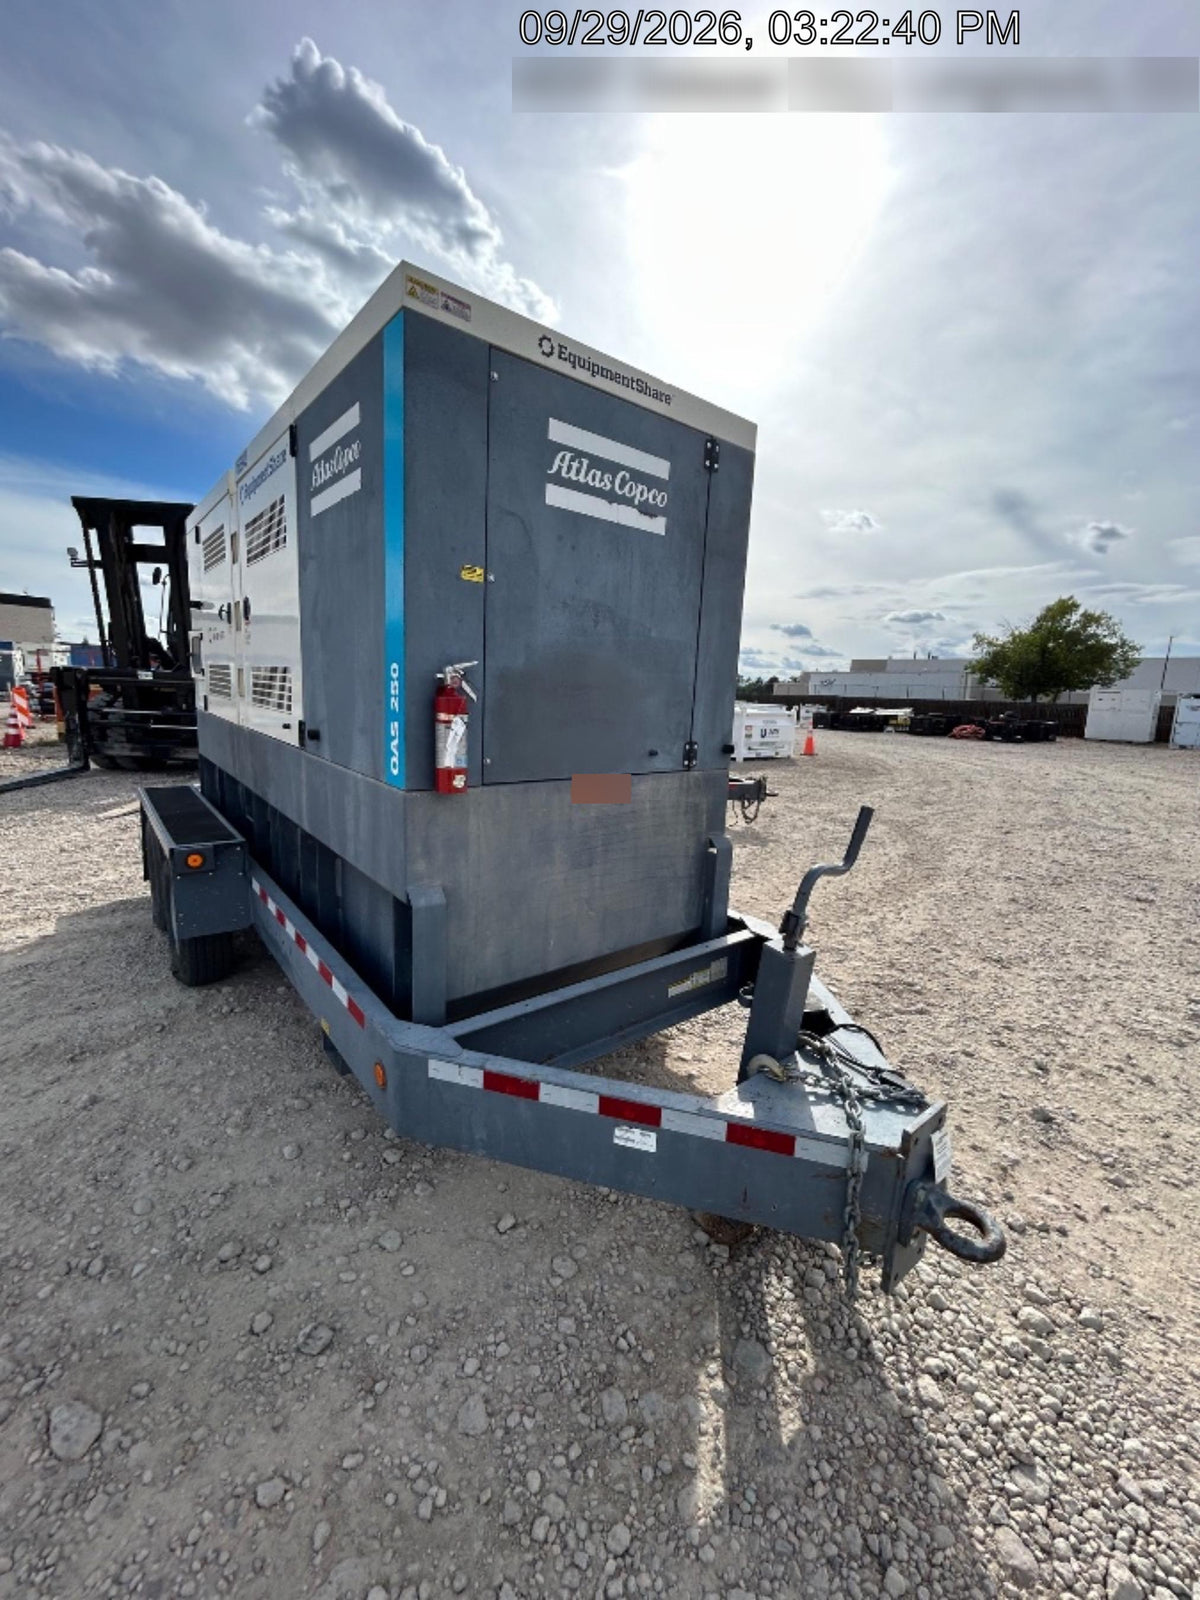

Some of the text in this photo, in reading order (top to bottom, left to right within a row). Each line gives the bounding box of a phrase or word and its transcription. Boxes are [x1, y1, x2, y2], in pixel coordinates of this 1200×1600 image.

[557, 342, 672, 406] EquipmentShare
[547, 451, 668, 508] Atlas Copco
[390, 662, 399, 712] 250
